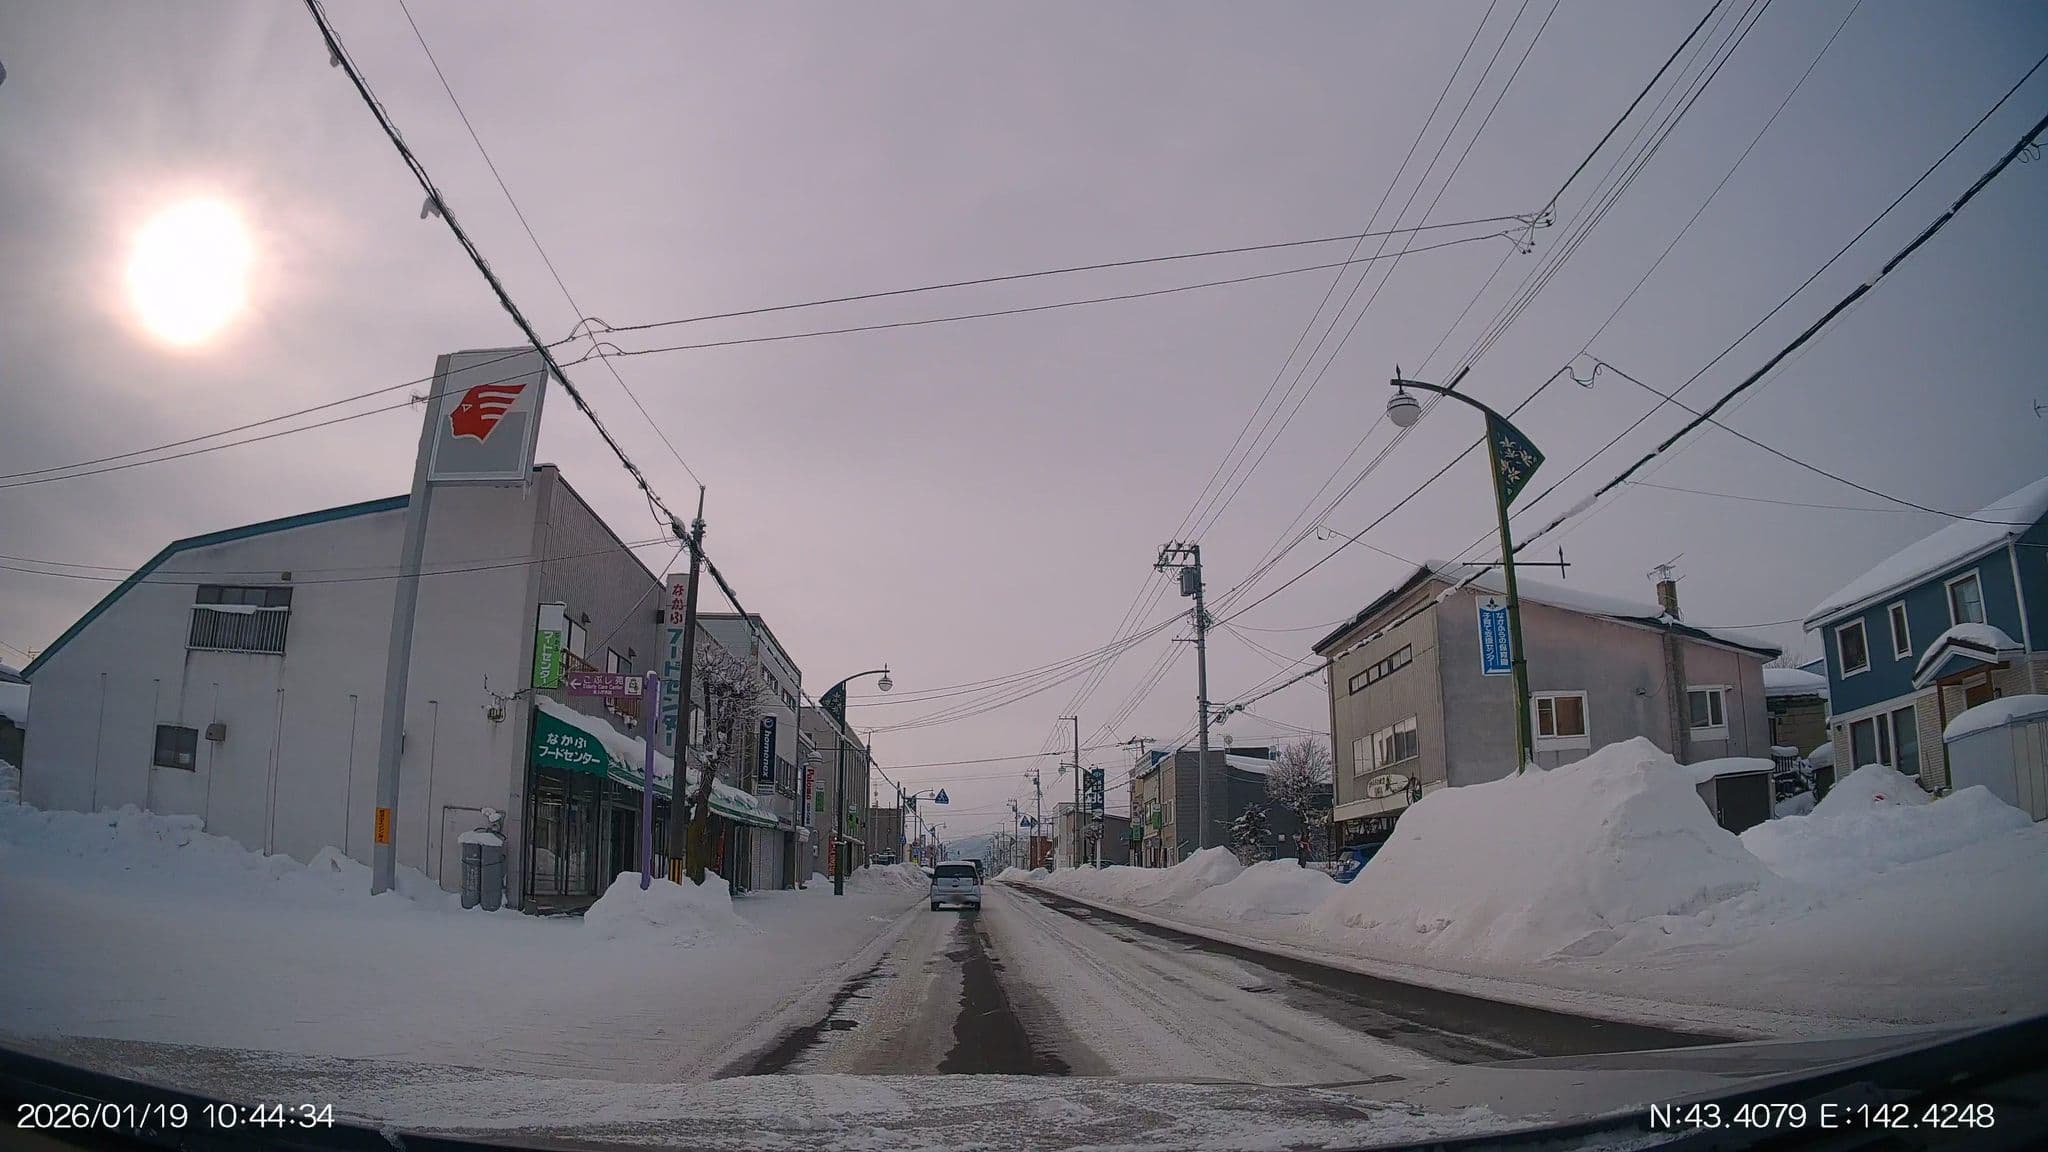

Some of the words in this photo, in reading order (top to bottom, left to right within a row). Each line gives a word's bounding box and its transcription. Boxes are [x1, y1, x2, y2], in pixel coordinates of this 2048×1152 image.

[670, 583, 684, 625] なかふ
[540, 631, 554, 684] フードセンター
[583, 675, 624, 685] こぶし苑
[661, 628, 682, 746] フードセンター
[538, 745, 601, 766] フードセンター
[547, 732, 587, 748] なかふ
[806, 768, 815, 801] Paloma
